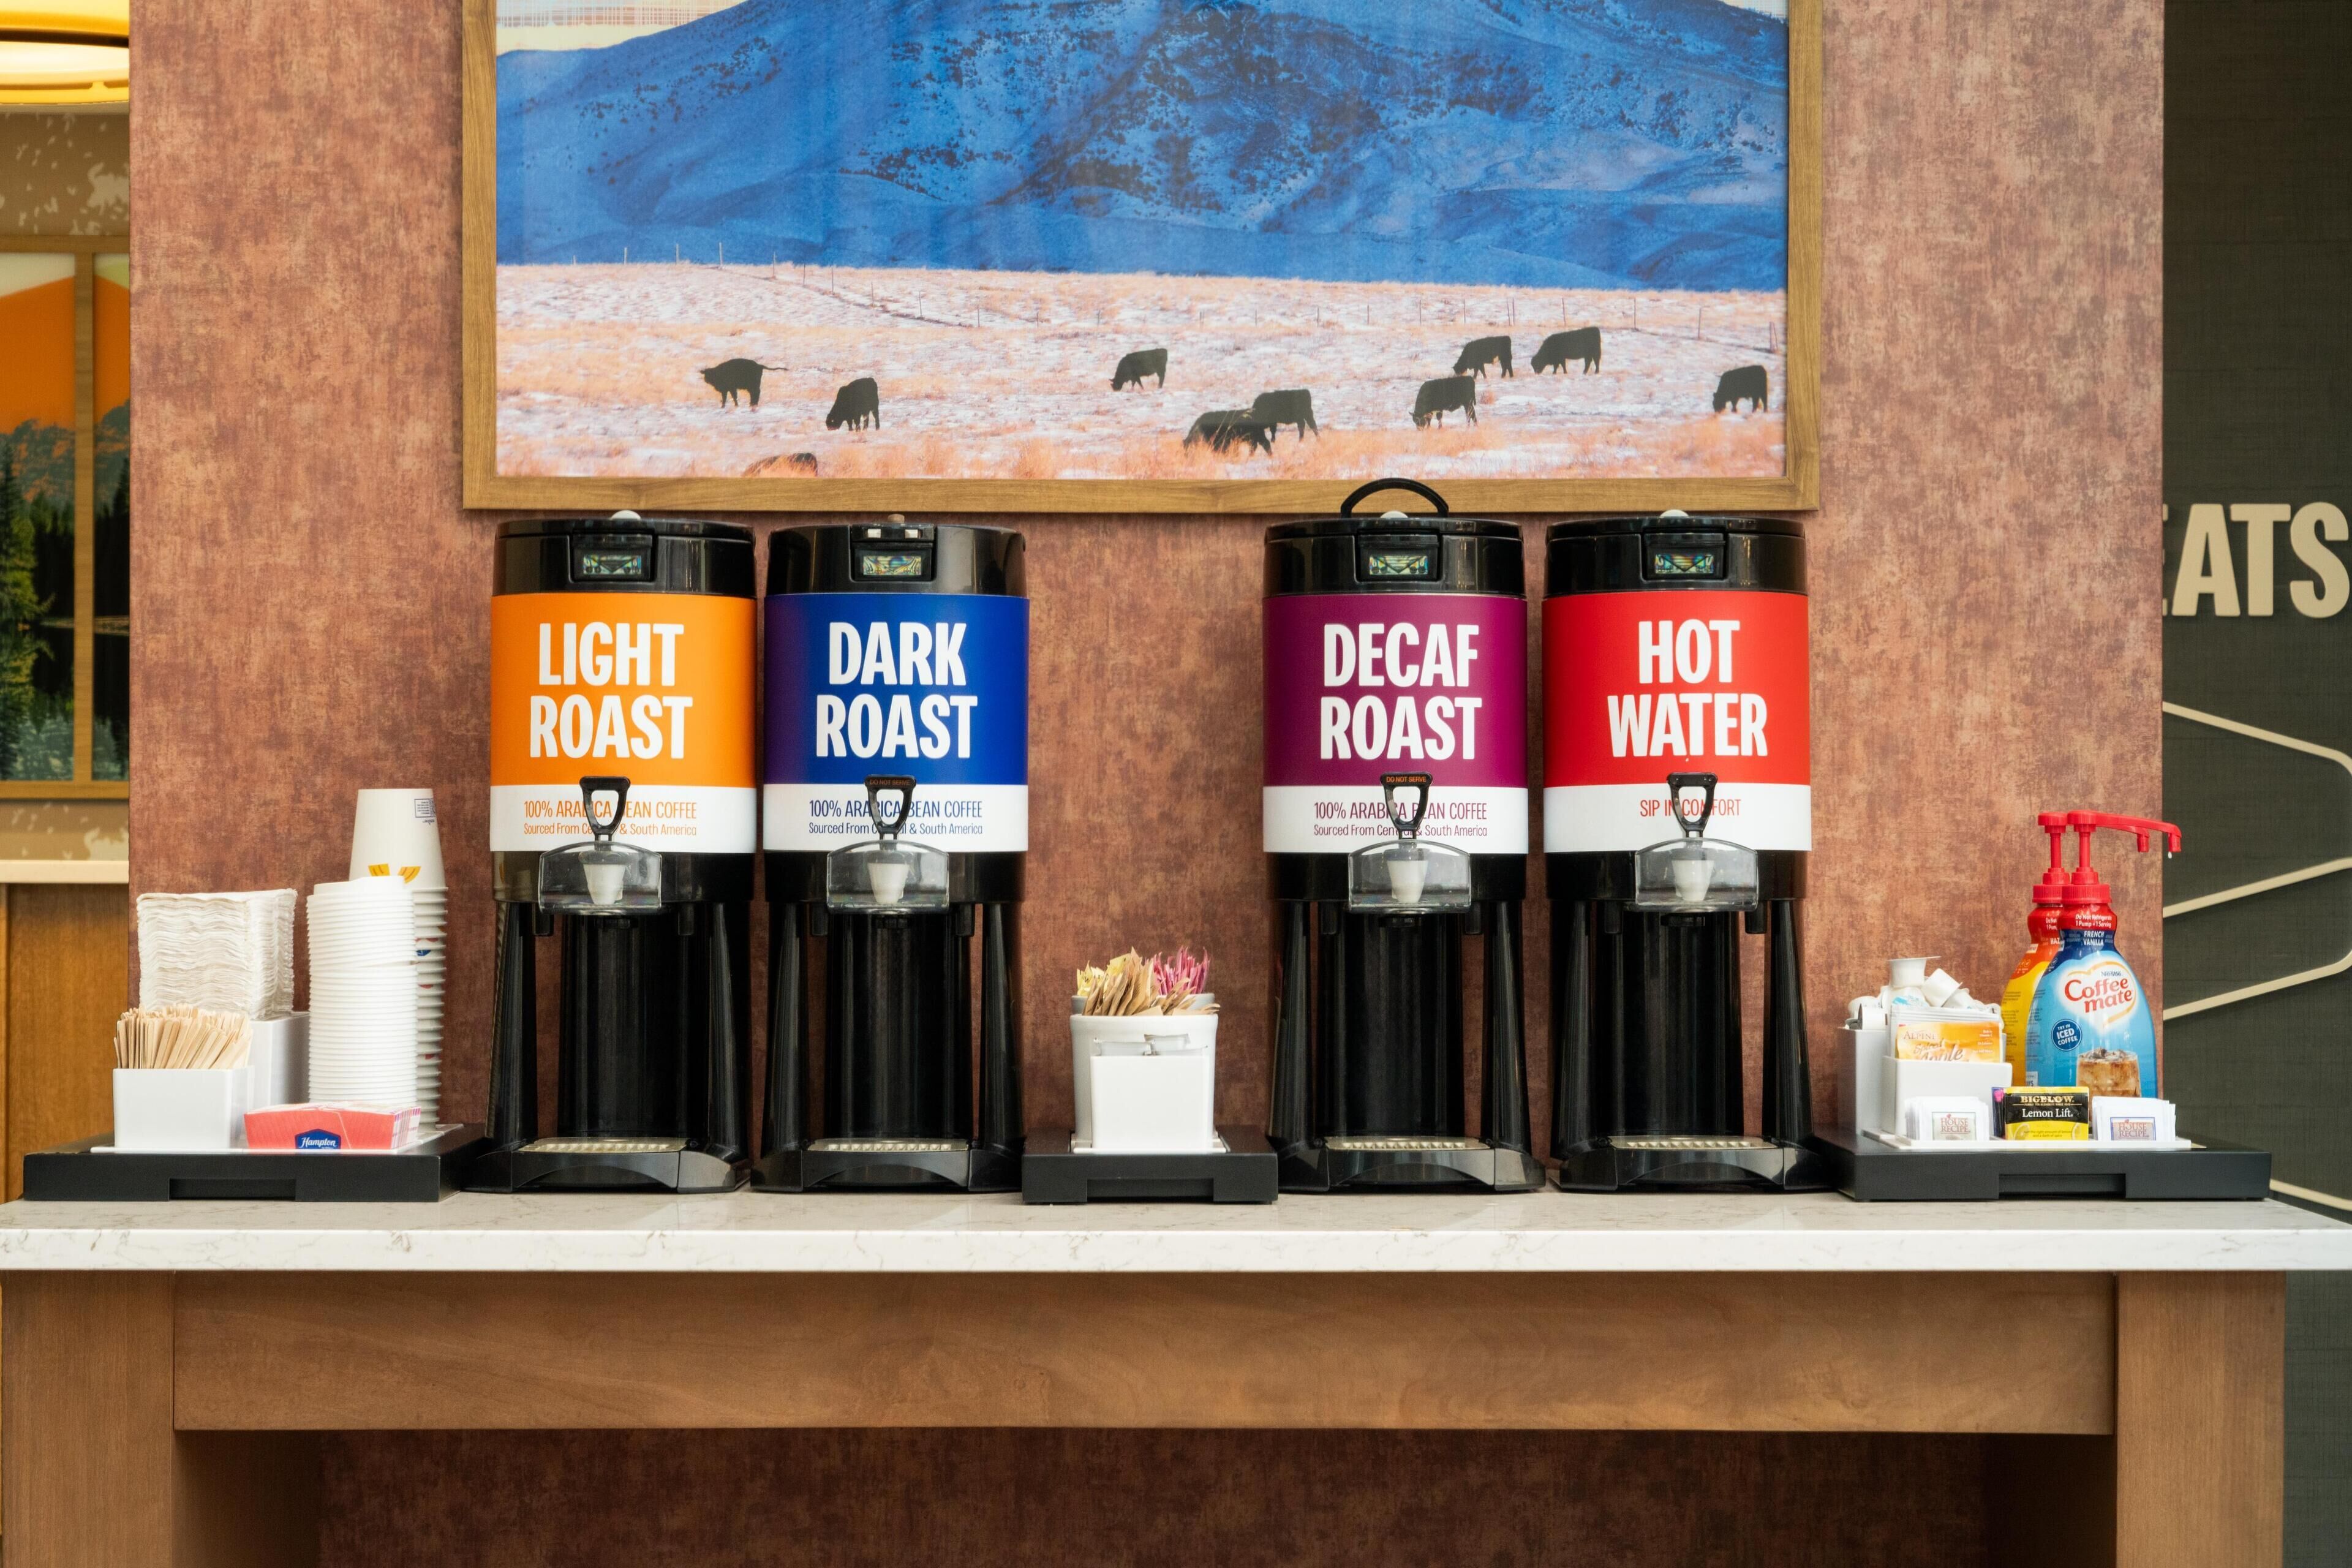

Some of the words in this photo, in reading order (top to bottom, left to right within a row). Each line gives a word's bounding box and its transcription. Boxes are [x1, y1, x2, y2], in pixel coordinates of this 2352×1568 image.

[2163, 502, 2350, 618] ATS
[539, 622, 684, 686] LIGHT
[829, 622, 967, 686] DARK
[1324, 623, 1479, 687] DECAF
[1638, 619, 1740, 684] HOT
[530, 695, 693, 759] ROAST
[816, 694, 978, 759] ROAST
[1321, 696, 1482, 760] ROAST
[1607, 693, 1768, 756] WATER
[524, 801, 552, 818] 100%
[556, 801, 612, 818] ARAICA
[624, 801, 651, 819] EAN
[656, 802, 696, 819] COFFEE
[809, 800, 841, 818] 100%
[944, 801, 982, 818] COFFEE
[1314, 802, 1346, 819] 100%
[1412, 802, 1445, 820] BAN
[1450, 802, 1487, 820] COFFEE
[1640, 800, 1660, 816] SIP
[524, 823, 554, 834] Sourced
[557, 823, 579, 834] From
[620, 823, 627, 835] &
[631, 823, 658, 835] South
[662, 824, 696, 835] America
[809, 822, 843, 834] Sourced
[846, 823, 869, 834] From
[909, 823, 917, 834] &
[920, 823, 946, 834] South
[949, 823, 982, 835] America
[1314, 824, 1348, 836] Sourced
[1351, 824, 1374, 836] From
[1425, 824, 1452, 836] South
[1455, 825, 1487, 837] America
[2065, 978, 2129, 1001] Coffee
[2084, 990, 2132, 1013] mate
[1904, 1031, 1936, 1039] ALPINE
[2057, 1028, 2075, 1039] ICED
[2057, 1036, 2078, 1046] COFFEE
[1940, 1117, 1968, 1126] HOUSE
[2022, 1108, 2053, 1118] Lemon
[2056, 1108, 2071, 1118] Lift
[2119, 1122, 2147, 1131] HOUSE
[298, 1137, 337, 1148] Hampton
